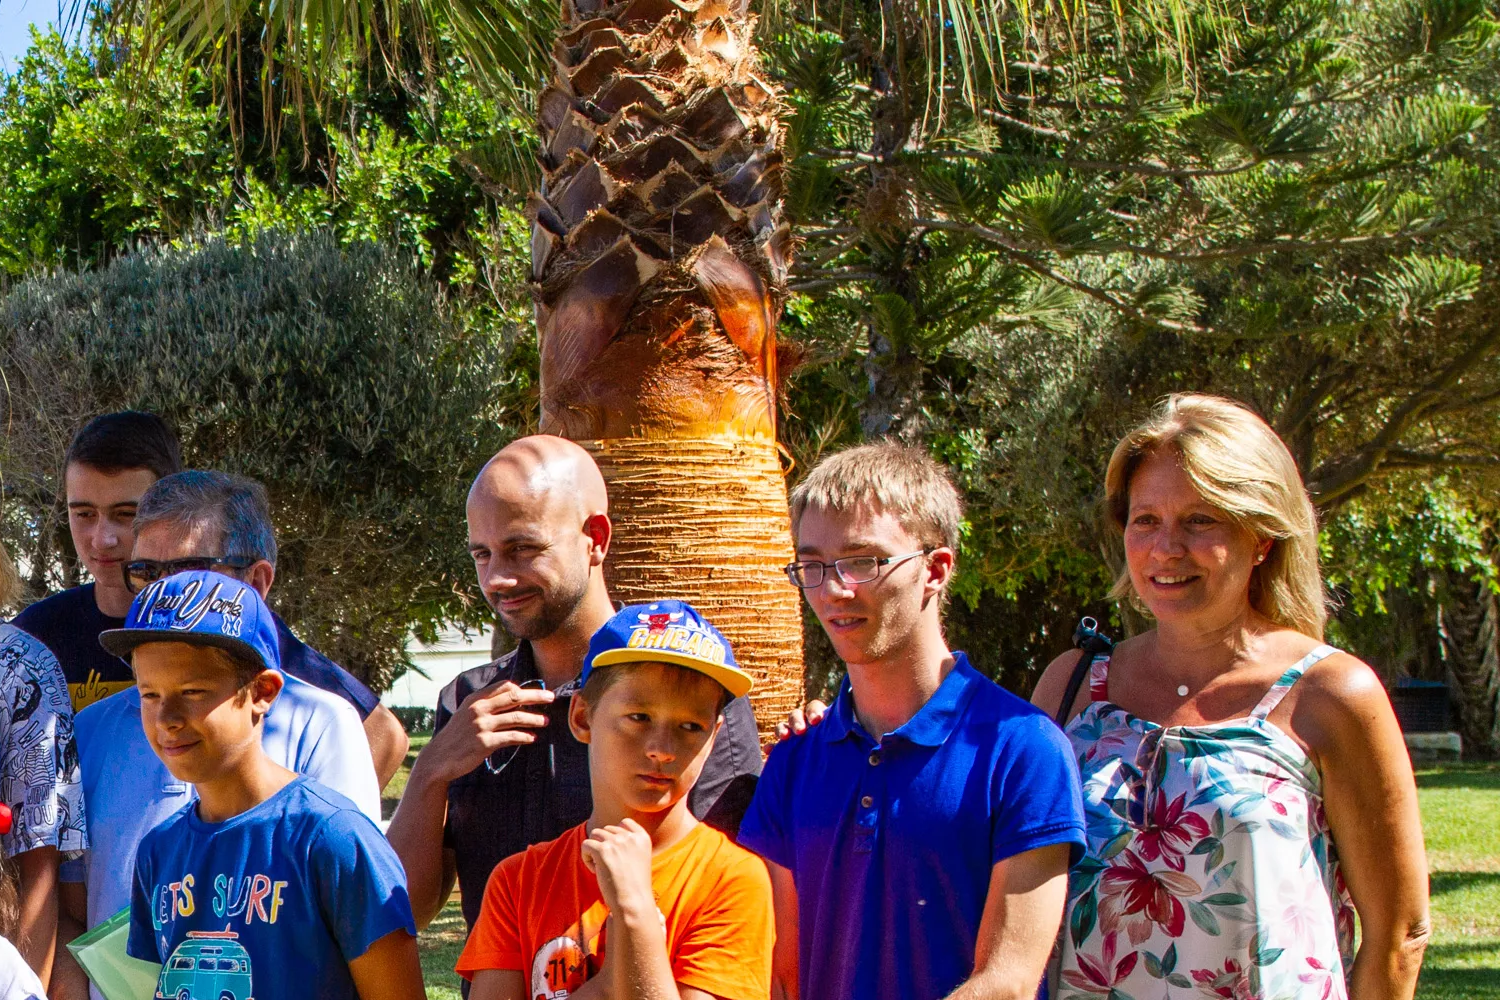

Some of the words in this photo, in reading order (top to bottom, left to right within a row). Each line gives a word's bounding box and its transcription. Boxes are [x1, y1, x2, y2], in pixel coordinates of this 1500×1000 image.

[137, 578, 182, 623] New
[175, 579, 246, 630] York
[626, 627, 727, 665] CHICAGO
[151, 873, 196, 931] LETS
[212, 873, 289, 925] SURF
[549, 957, 567, 986] 71
